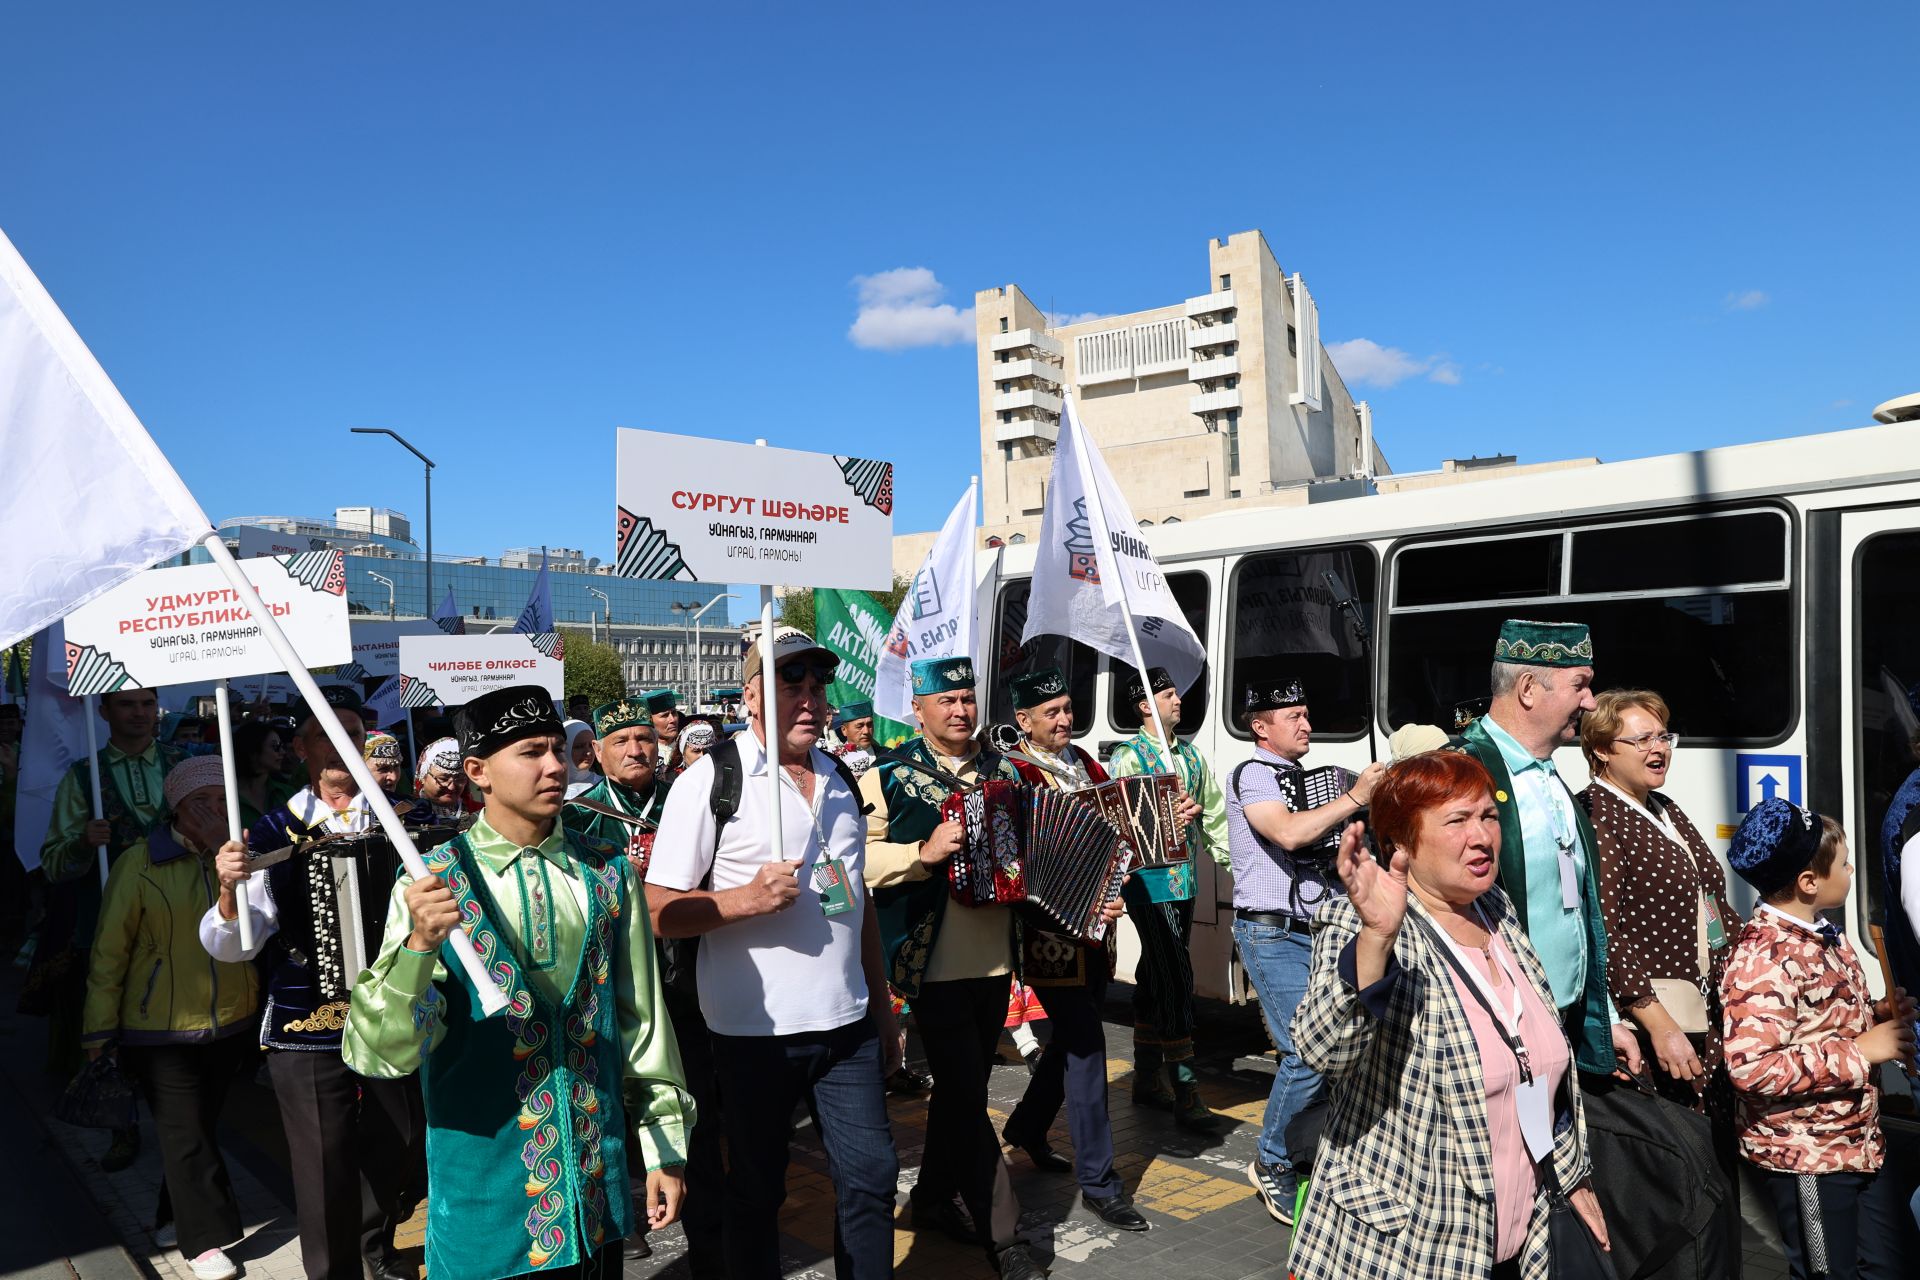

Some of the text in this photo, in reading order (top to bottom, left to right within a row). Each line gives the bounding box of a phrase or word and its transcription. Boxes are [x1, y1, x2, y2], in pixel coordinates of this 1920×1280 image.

[671, 491, 849, 524] СУРГУТ ШӘҺӘРЕ
[708, 523, 757, 541] УЙНАГЫЗ,
[727, 545, 802, 562] ИГРАЙ, ГАРМОНЬ!
[1111, 530, 1155, 562] УЙНАГ
[150, 633, 198, 649] УЙНАГЫЗ,
[169, 645, 247, 664] ИГРАЙ, ГАРМОНЬ!
[428, 659, 536, 671] ЧИЛӘБЕ ӨЛКӘСЕ
